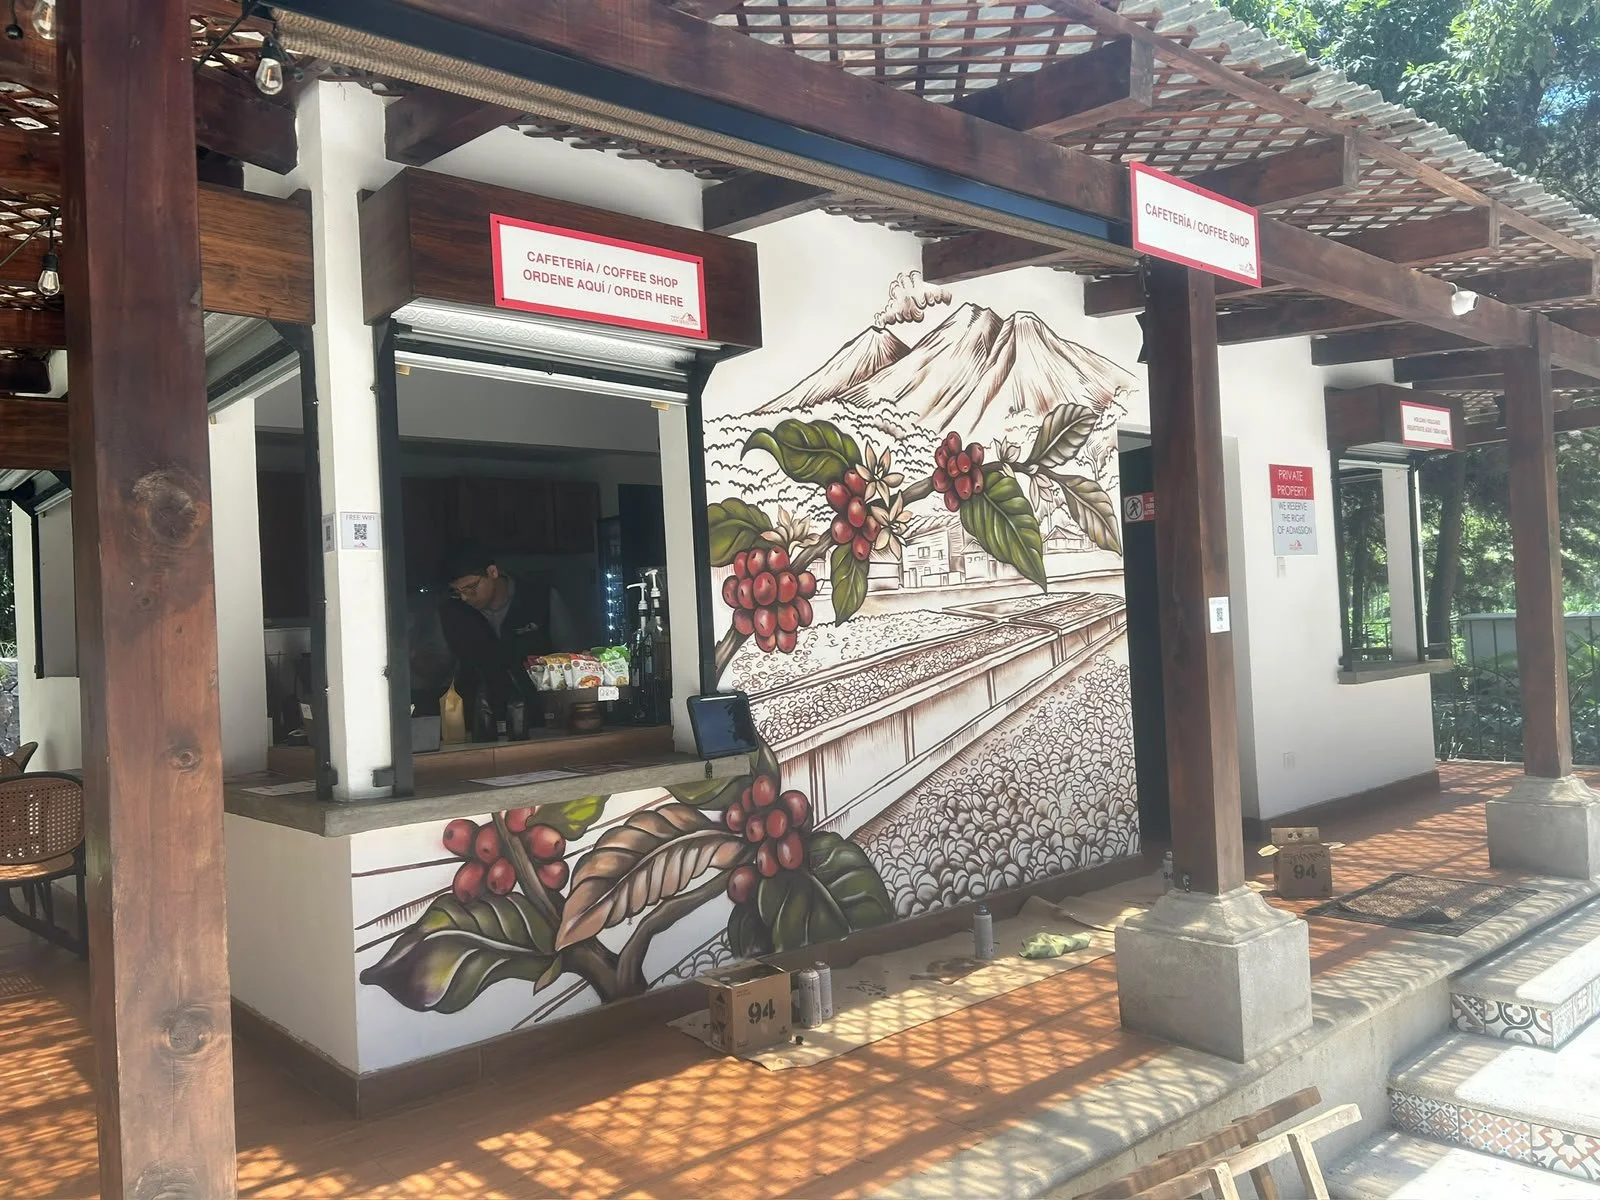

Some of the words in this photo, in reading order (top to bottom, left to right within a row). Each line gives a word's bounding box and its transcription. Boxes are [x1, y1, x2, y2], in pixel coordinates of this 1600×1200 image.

[1145, 202, 1192, 231] CAFETERÍA
[1197, 221, 1228, 241] COFFEE
[1229, 232, 1250, 248] SHOP
[527, 251, 594, 273] CAFETERÍA
[596, 264, 601, 273] /
[603, 265, 647, 283] COFFEE
[649, 274, 678, 288] SHOP
[523, 269, 574, 288] ORDENE
[577, 279, 605, 293] AQUÍ
[607, 284, 612, 294] /
[614, 285, 653, 302] ORDER
[655, 292, 684, 307] HERE
[1278, 469, 1303, 481] PRIVATE
[1277, 485, 1307, 496] PROPERTY
[1279, 501, 1286, 510] WE
[1287, 501, 1308, 511] RESERVE
[1281, 513, 1291, 522] THE
[1291, 513, 1305, 522] RIGHT
[1277, 525, 1285, 534] OF
[1286, 525, 1312, 534] ADMISSION
[1294, 863, 1317, 879] 94
[748, 999, 776, 1024] 94
